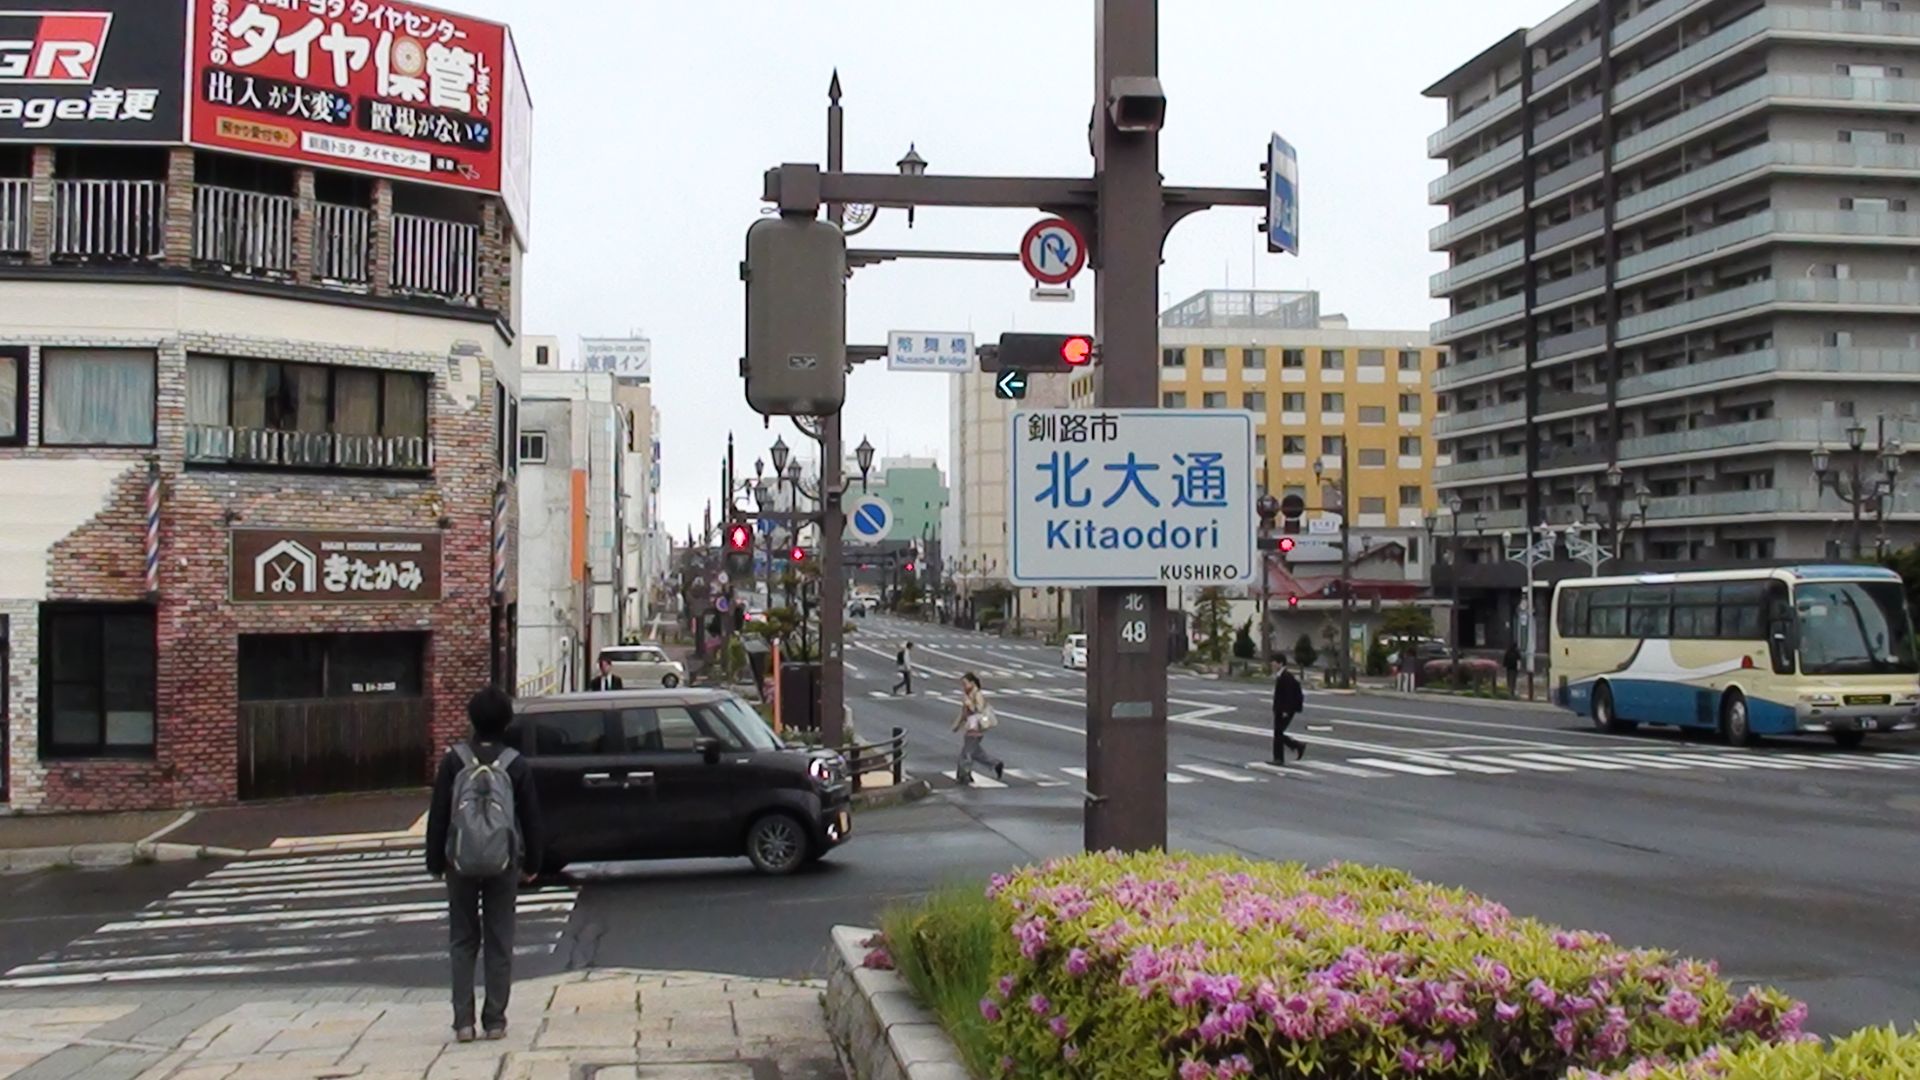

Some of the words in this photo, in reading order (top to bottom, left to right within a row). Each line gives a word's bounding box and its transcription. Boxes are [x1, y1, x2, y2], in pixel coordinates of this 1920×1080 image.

[208, 71, 334, 123] 出入が大変
[476, 52, 491, 116] します
[371, 100, 474, 143] 置場がない
[938, 355, 967, 367] Bridge
[1028, 413, 1119, 442] 釧路市
[1034, 451, 1228, 509] 北大通
[1046, 519, 1218, 549] Kitaodori
[323, 553, 423, 592] きたかみ
[1160, 564, 1238, 580] KUSHIRO
[1125, 593, 1144, 611] 北
[1122, 620, 1146, 643] 48
